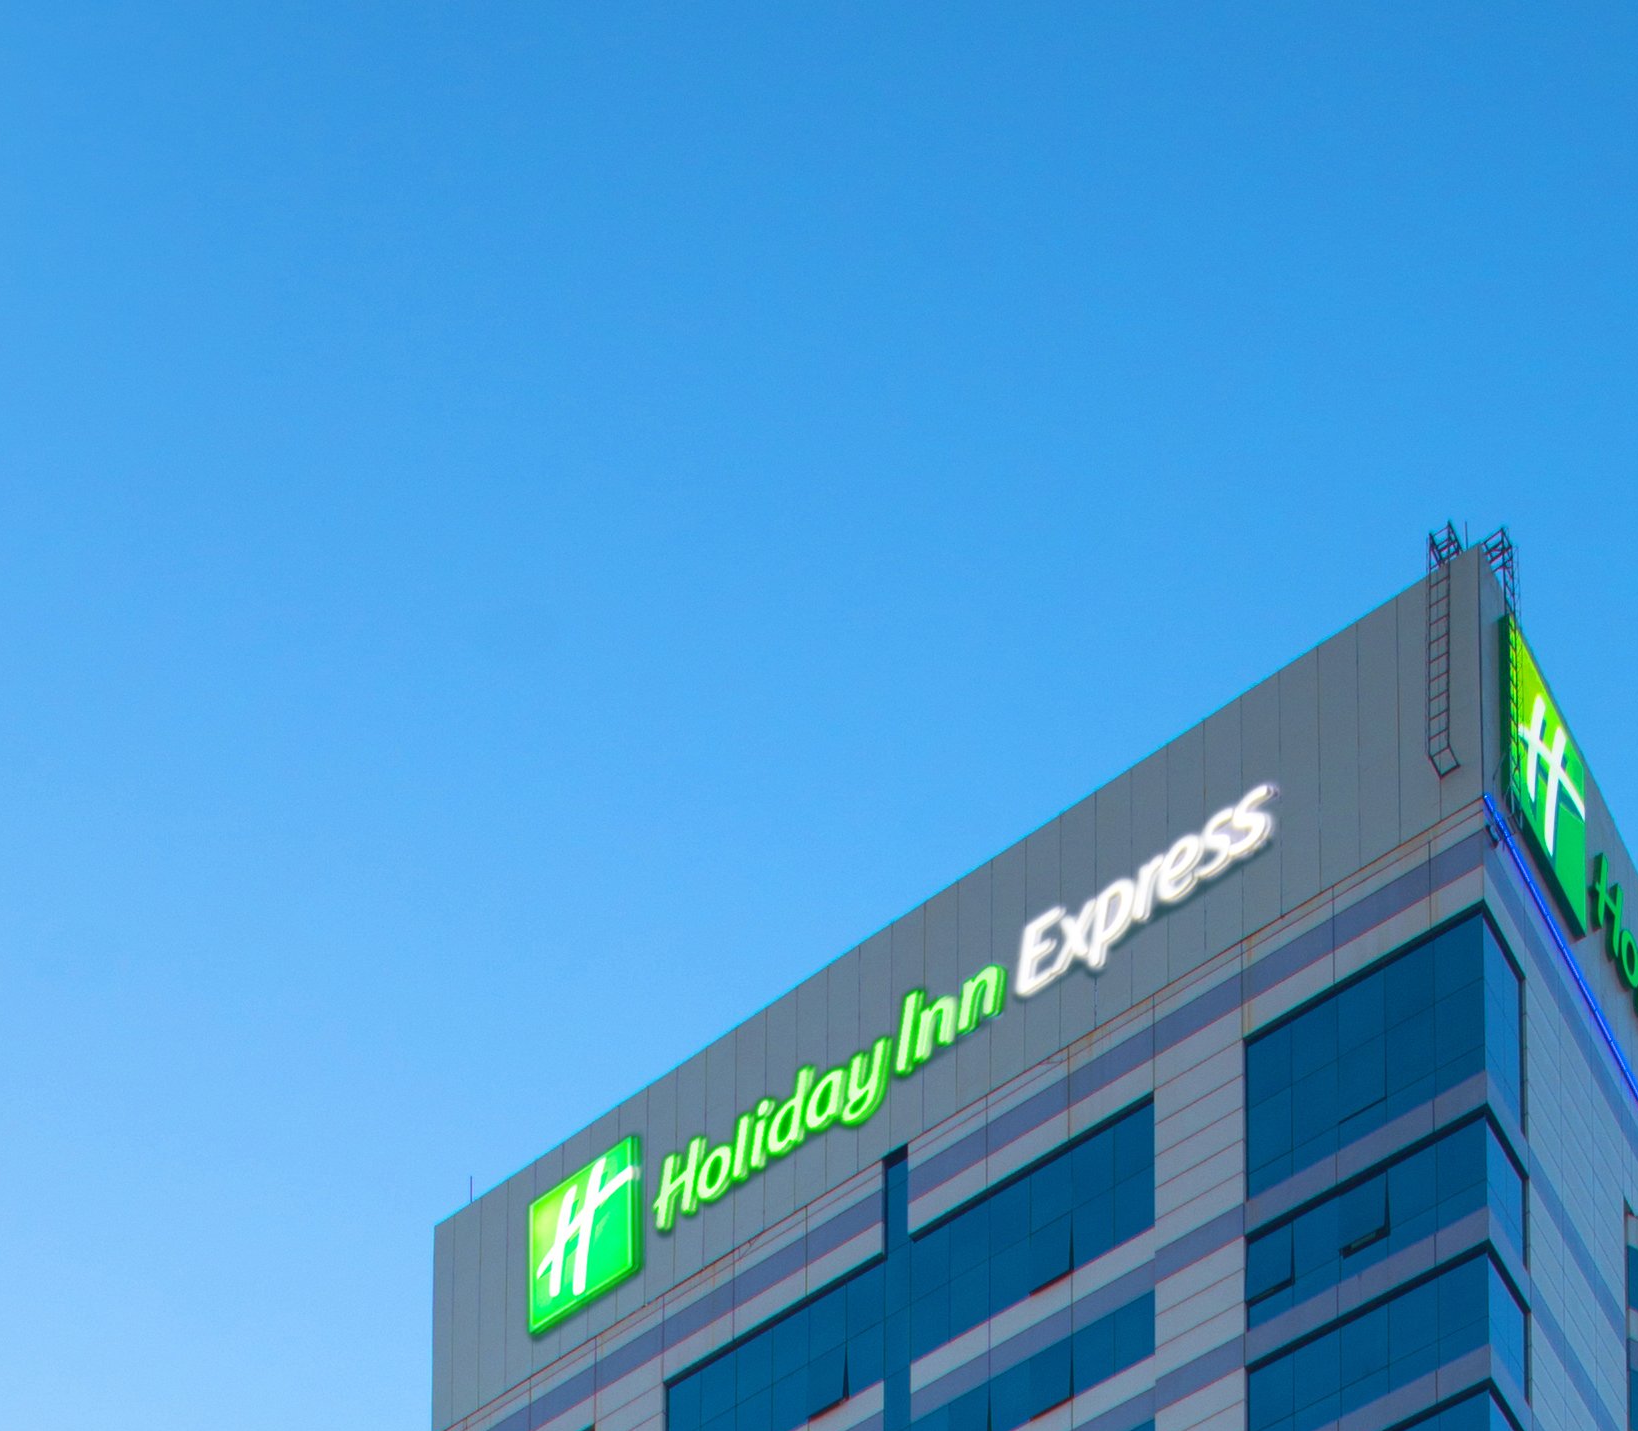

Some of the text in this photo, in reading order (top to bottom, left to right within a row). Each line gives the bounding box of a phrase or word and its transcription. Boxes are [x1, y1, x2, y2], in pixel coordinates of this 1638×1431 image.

[651, 782, 1281, 1233] Holiday Inn Express
